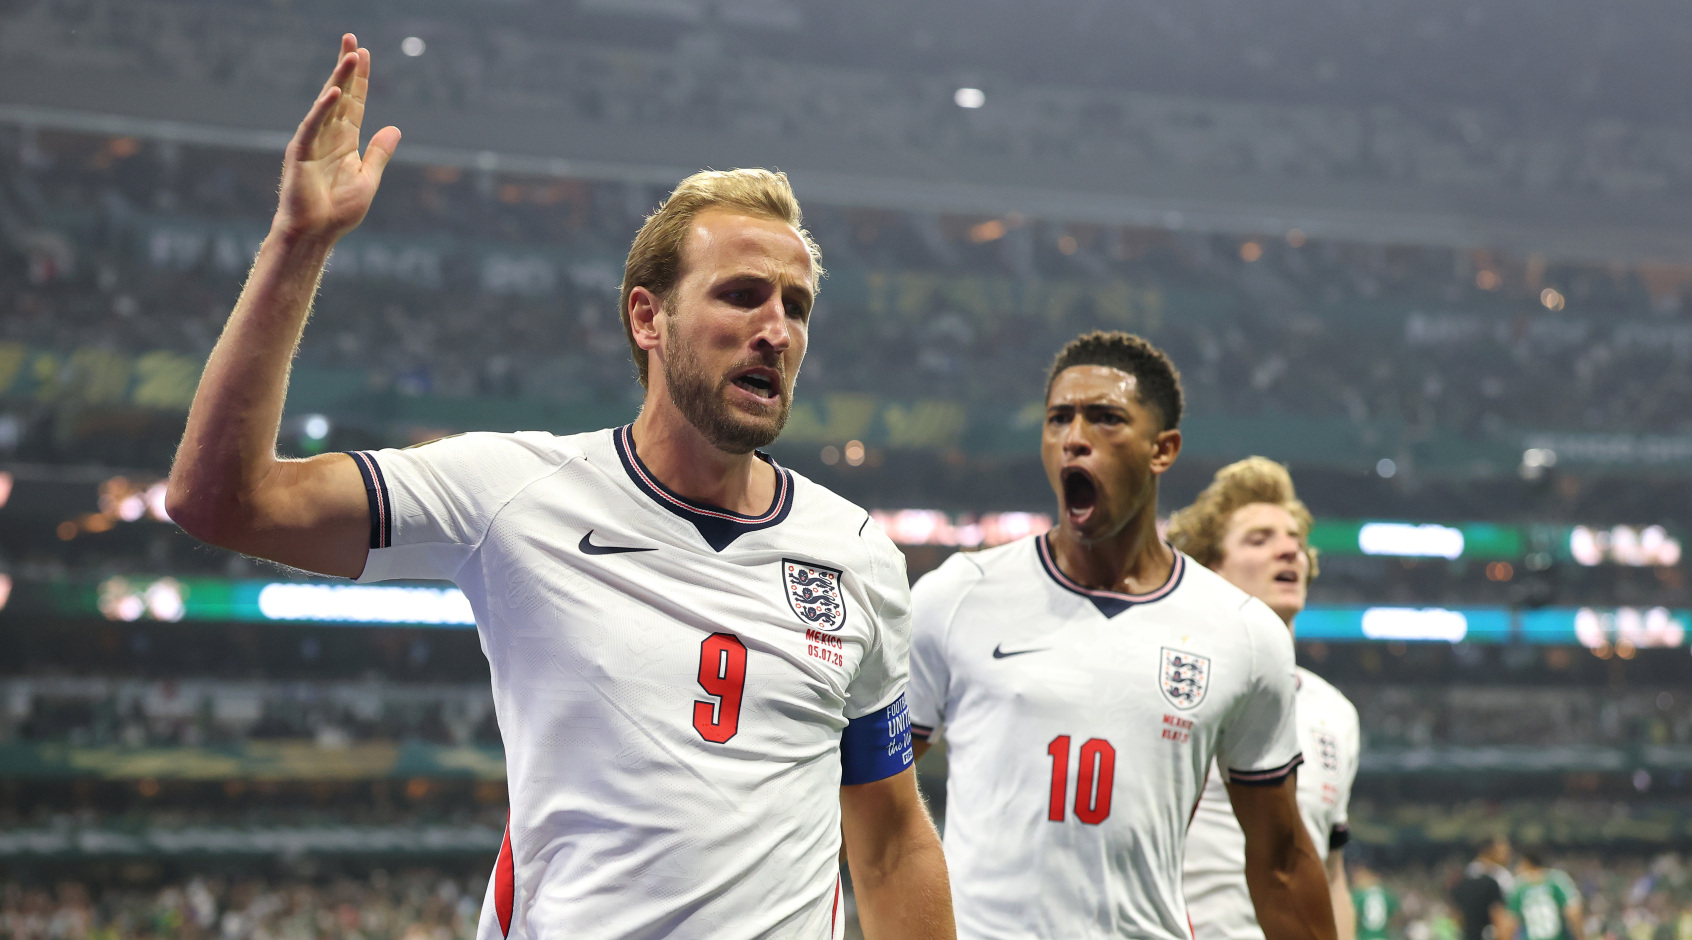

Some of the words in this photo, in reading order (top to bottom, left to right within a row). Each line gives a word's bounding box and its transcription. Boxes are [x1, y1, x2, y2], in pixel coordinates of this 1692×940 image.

[806, 629, 842, 649] MEXICO
[808, 644, 842, 666] 05.07.26
[693, 632, 747, 744] 9
[886, 738, 903, 756] the
[1047, 734, 1116, 825] 10
